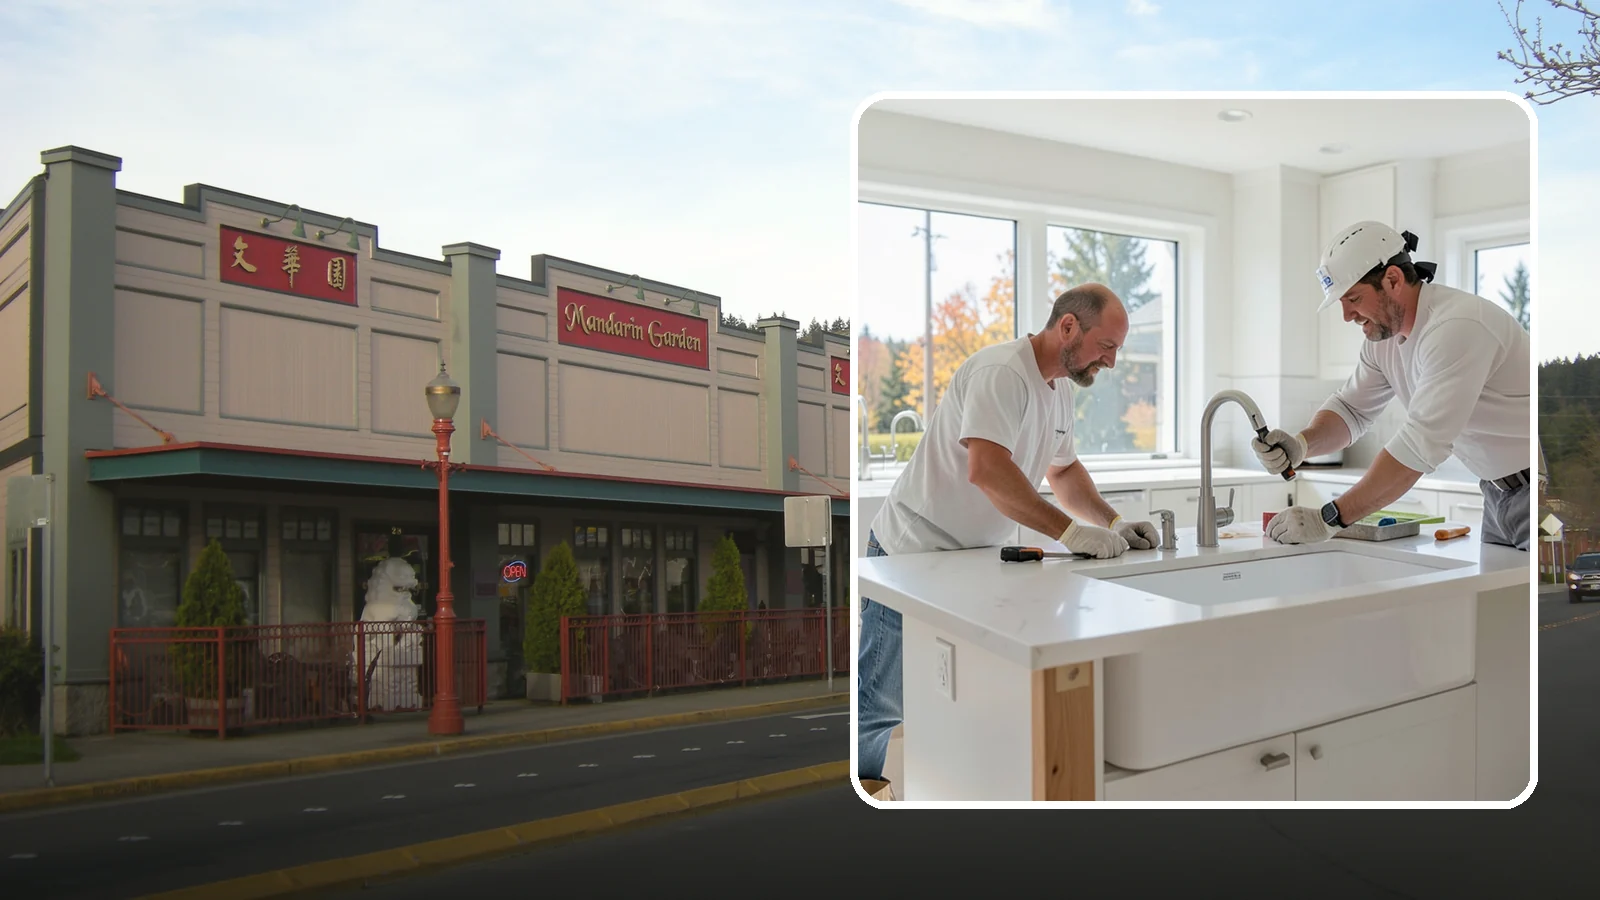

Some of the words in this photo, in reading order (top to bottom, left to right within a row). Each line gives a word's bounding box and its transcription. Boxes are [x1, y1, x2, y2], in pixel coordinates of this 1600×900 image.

[231, 236, 345, 290] 文華園
[564, 302, 644, 341] Mandarin
[648, 320, 702, 352] Garden
[503, 565, 527, 578] OPEN
